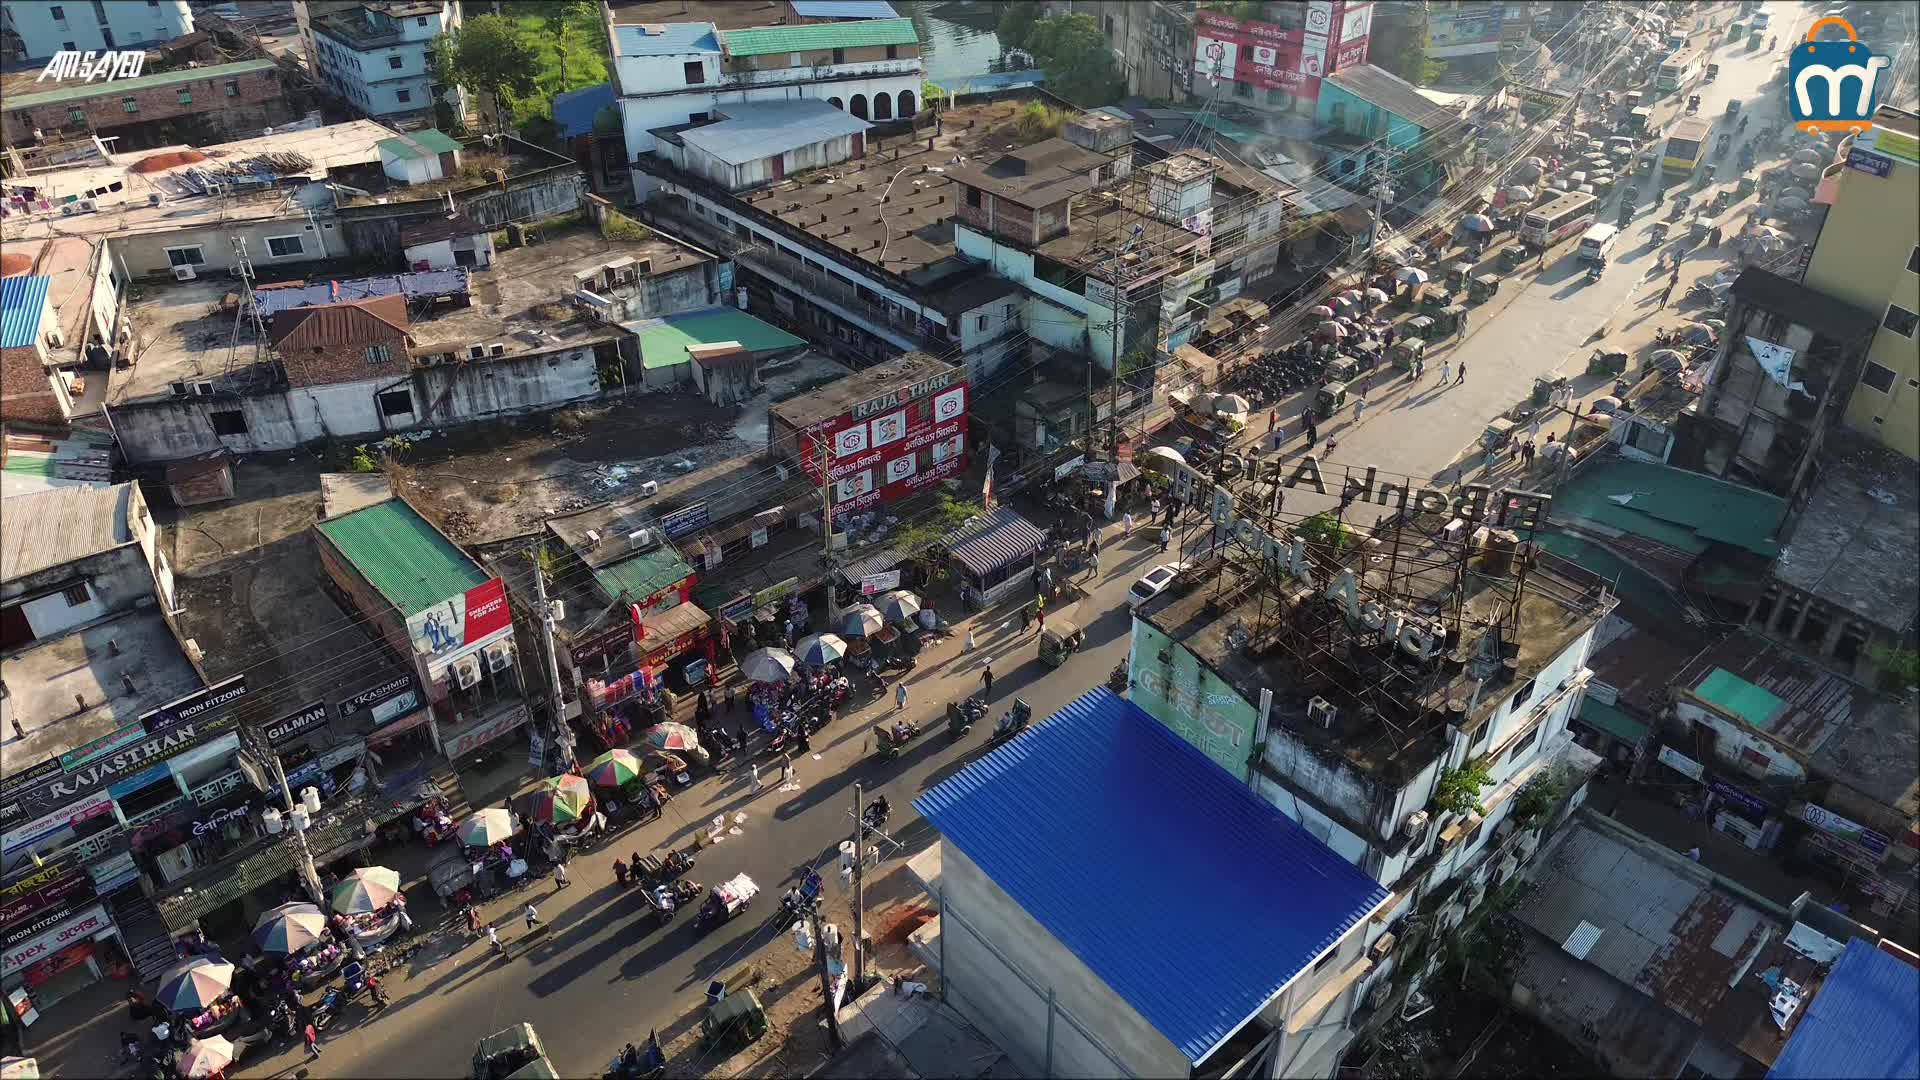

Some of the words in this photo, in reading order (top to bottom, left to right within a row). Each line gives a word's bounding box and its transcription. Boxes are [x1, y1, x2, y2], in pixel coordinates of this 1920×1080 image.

[857, 374, 950, 418] RAJASTHAN
[179, 703, 205, 719] IRON
[205, 685, 247, 709] FITZONE
[49, 723, 196, 799] RAJASTHAN
[7, 928, 32, 944] IRON
[32, 908, 71, 932] FITZONE
[2, 942, 47, 969] Apex
